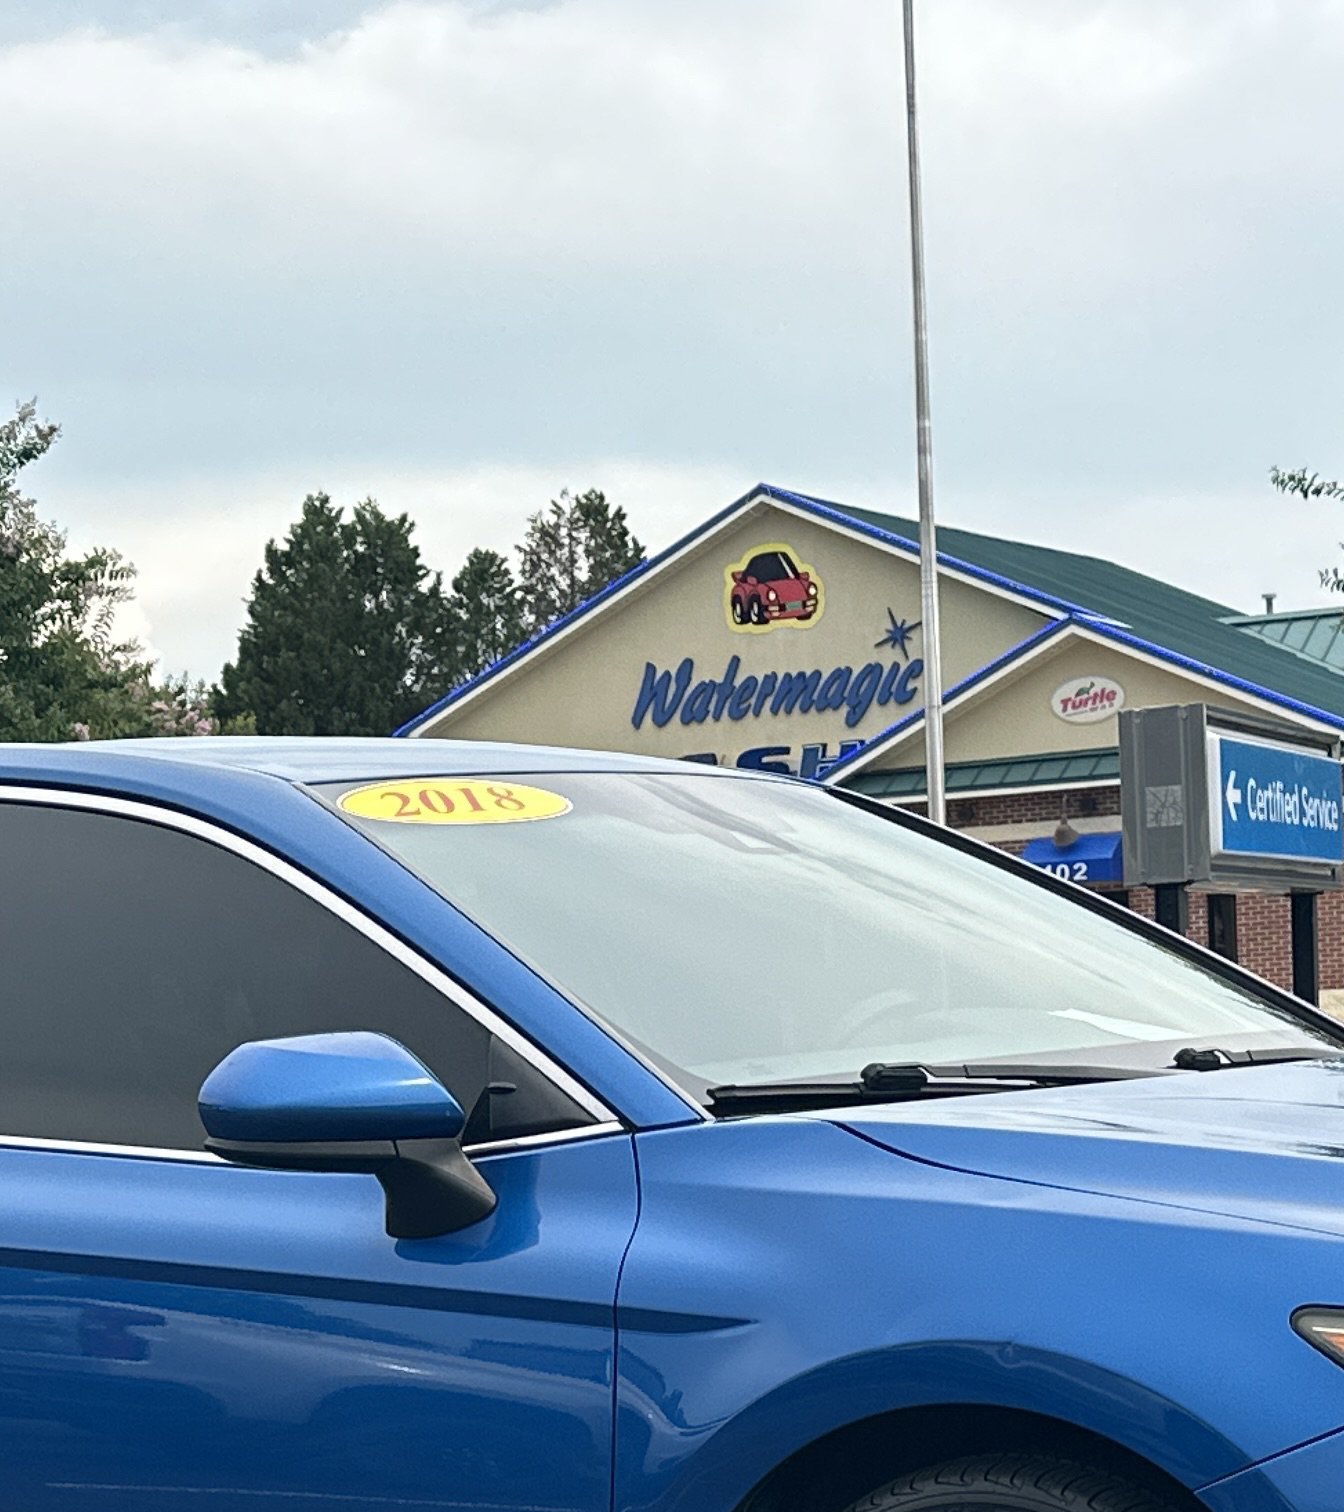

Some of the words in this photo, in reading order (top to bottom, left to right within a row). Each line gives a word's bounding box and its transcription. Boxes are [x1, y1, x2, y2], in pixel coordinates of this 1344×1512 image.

[631, 655, 924, 730] Watermagic
[1060, 687, 1117, 713] Turtle
[380, 786, 525, 817] 2018
[1247, 778, 1299, 825] Certified
[1301, 786, 1338, 832] Service
